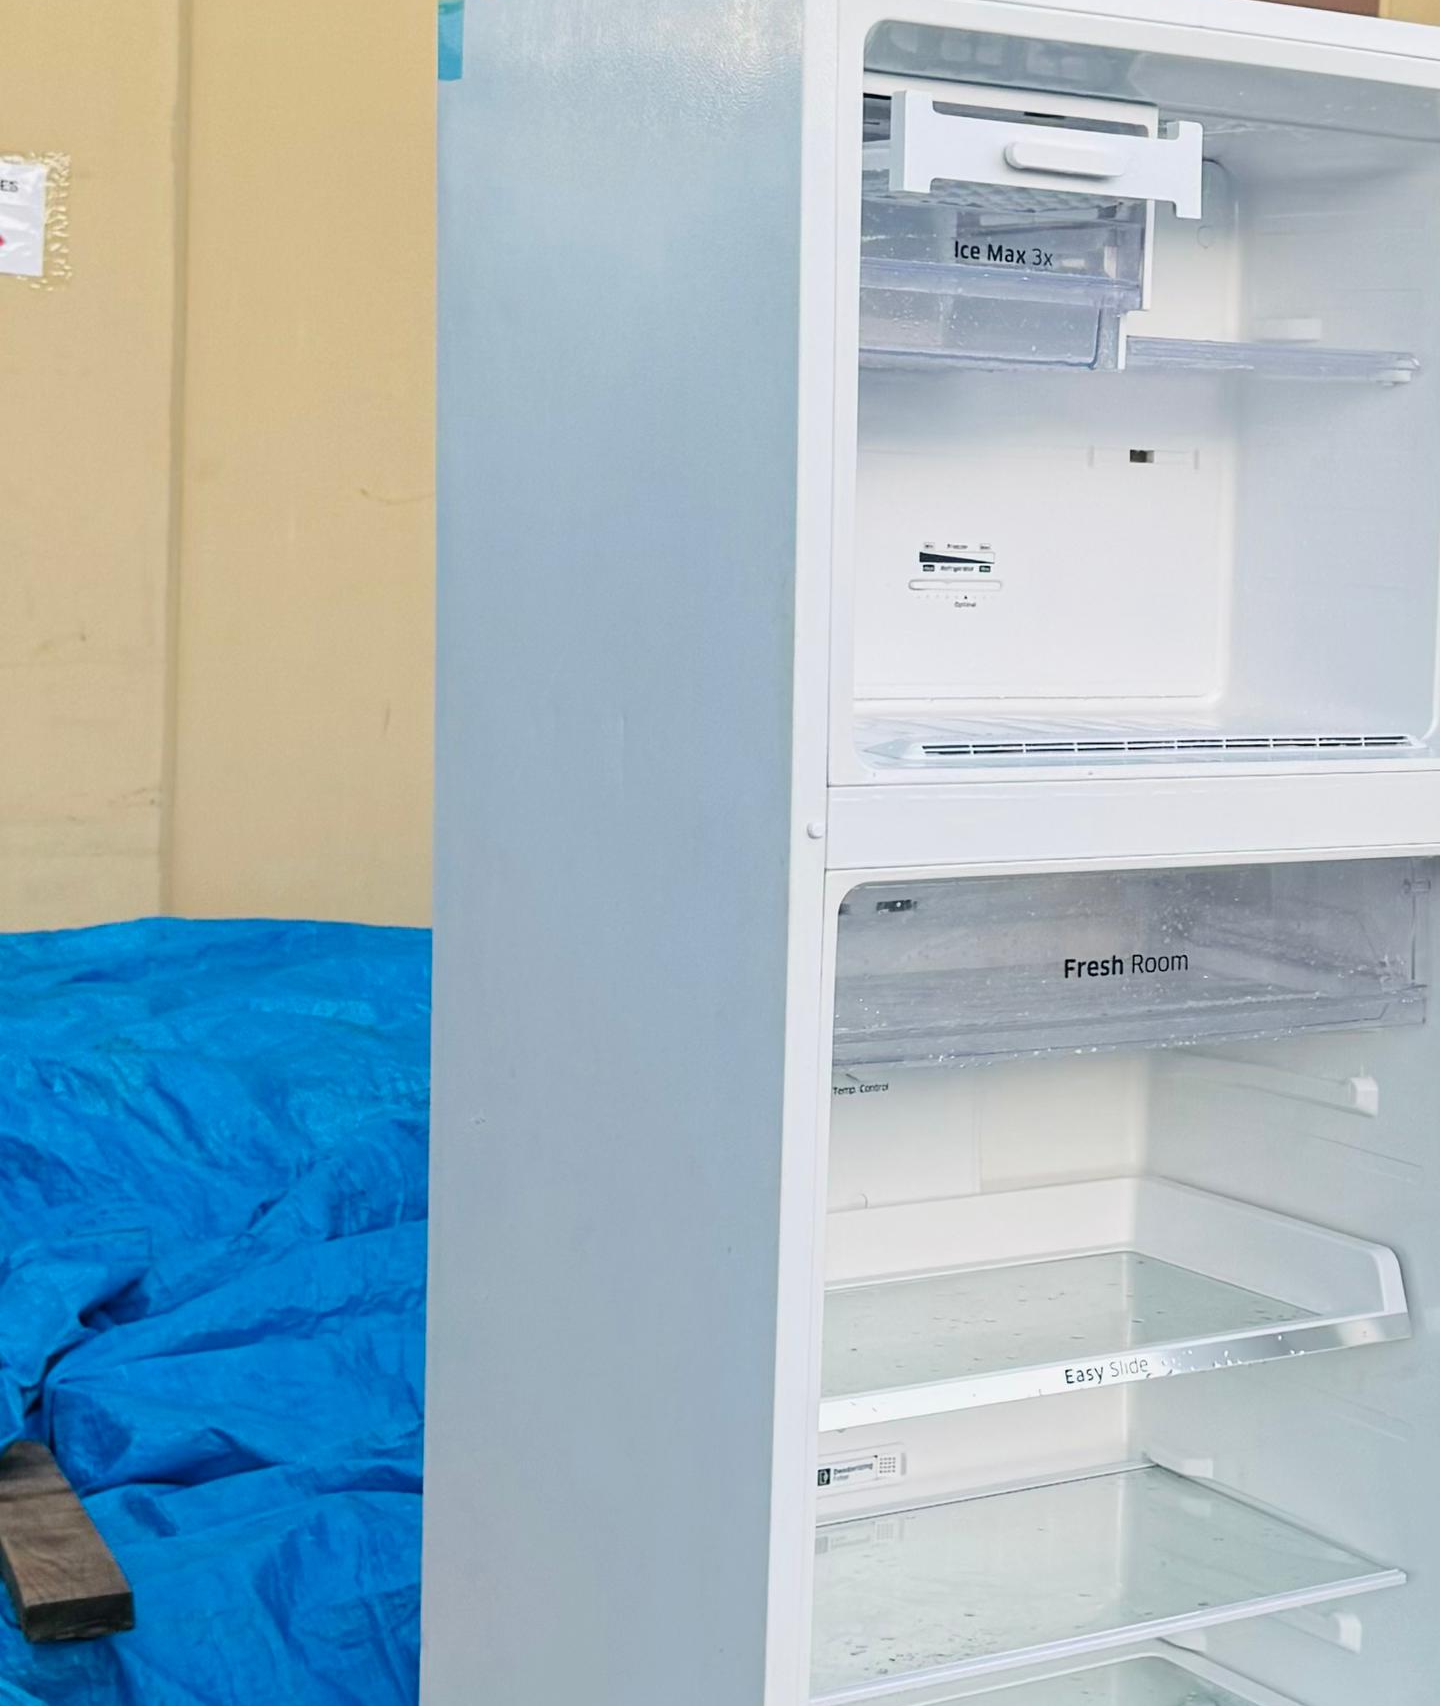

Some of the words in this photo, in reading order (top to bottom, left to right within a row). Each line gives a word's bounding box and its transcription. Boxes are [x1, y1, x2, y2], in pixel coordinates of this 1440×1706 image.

[954, 240, 980, 260] Ice
[987, 243, 1026, 264] Max
[1032, 248, 1053, 266] 3x
[1064, 955, 1124, 979] Fresh
[1131, 954, 1188, 974] Room
[1064, 1366, 1104, 1385] Easy
[1109, 1358, 1149, 1378] Slide
